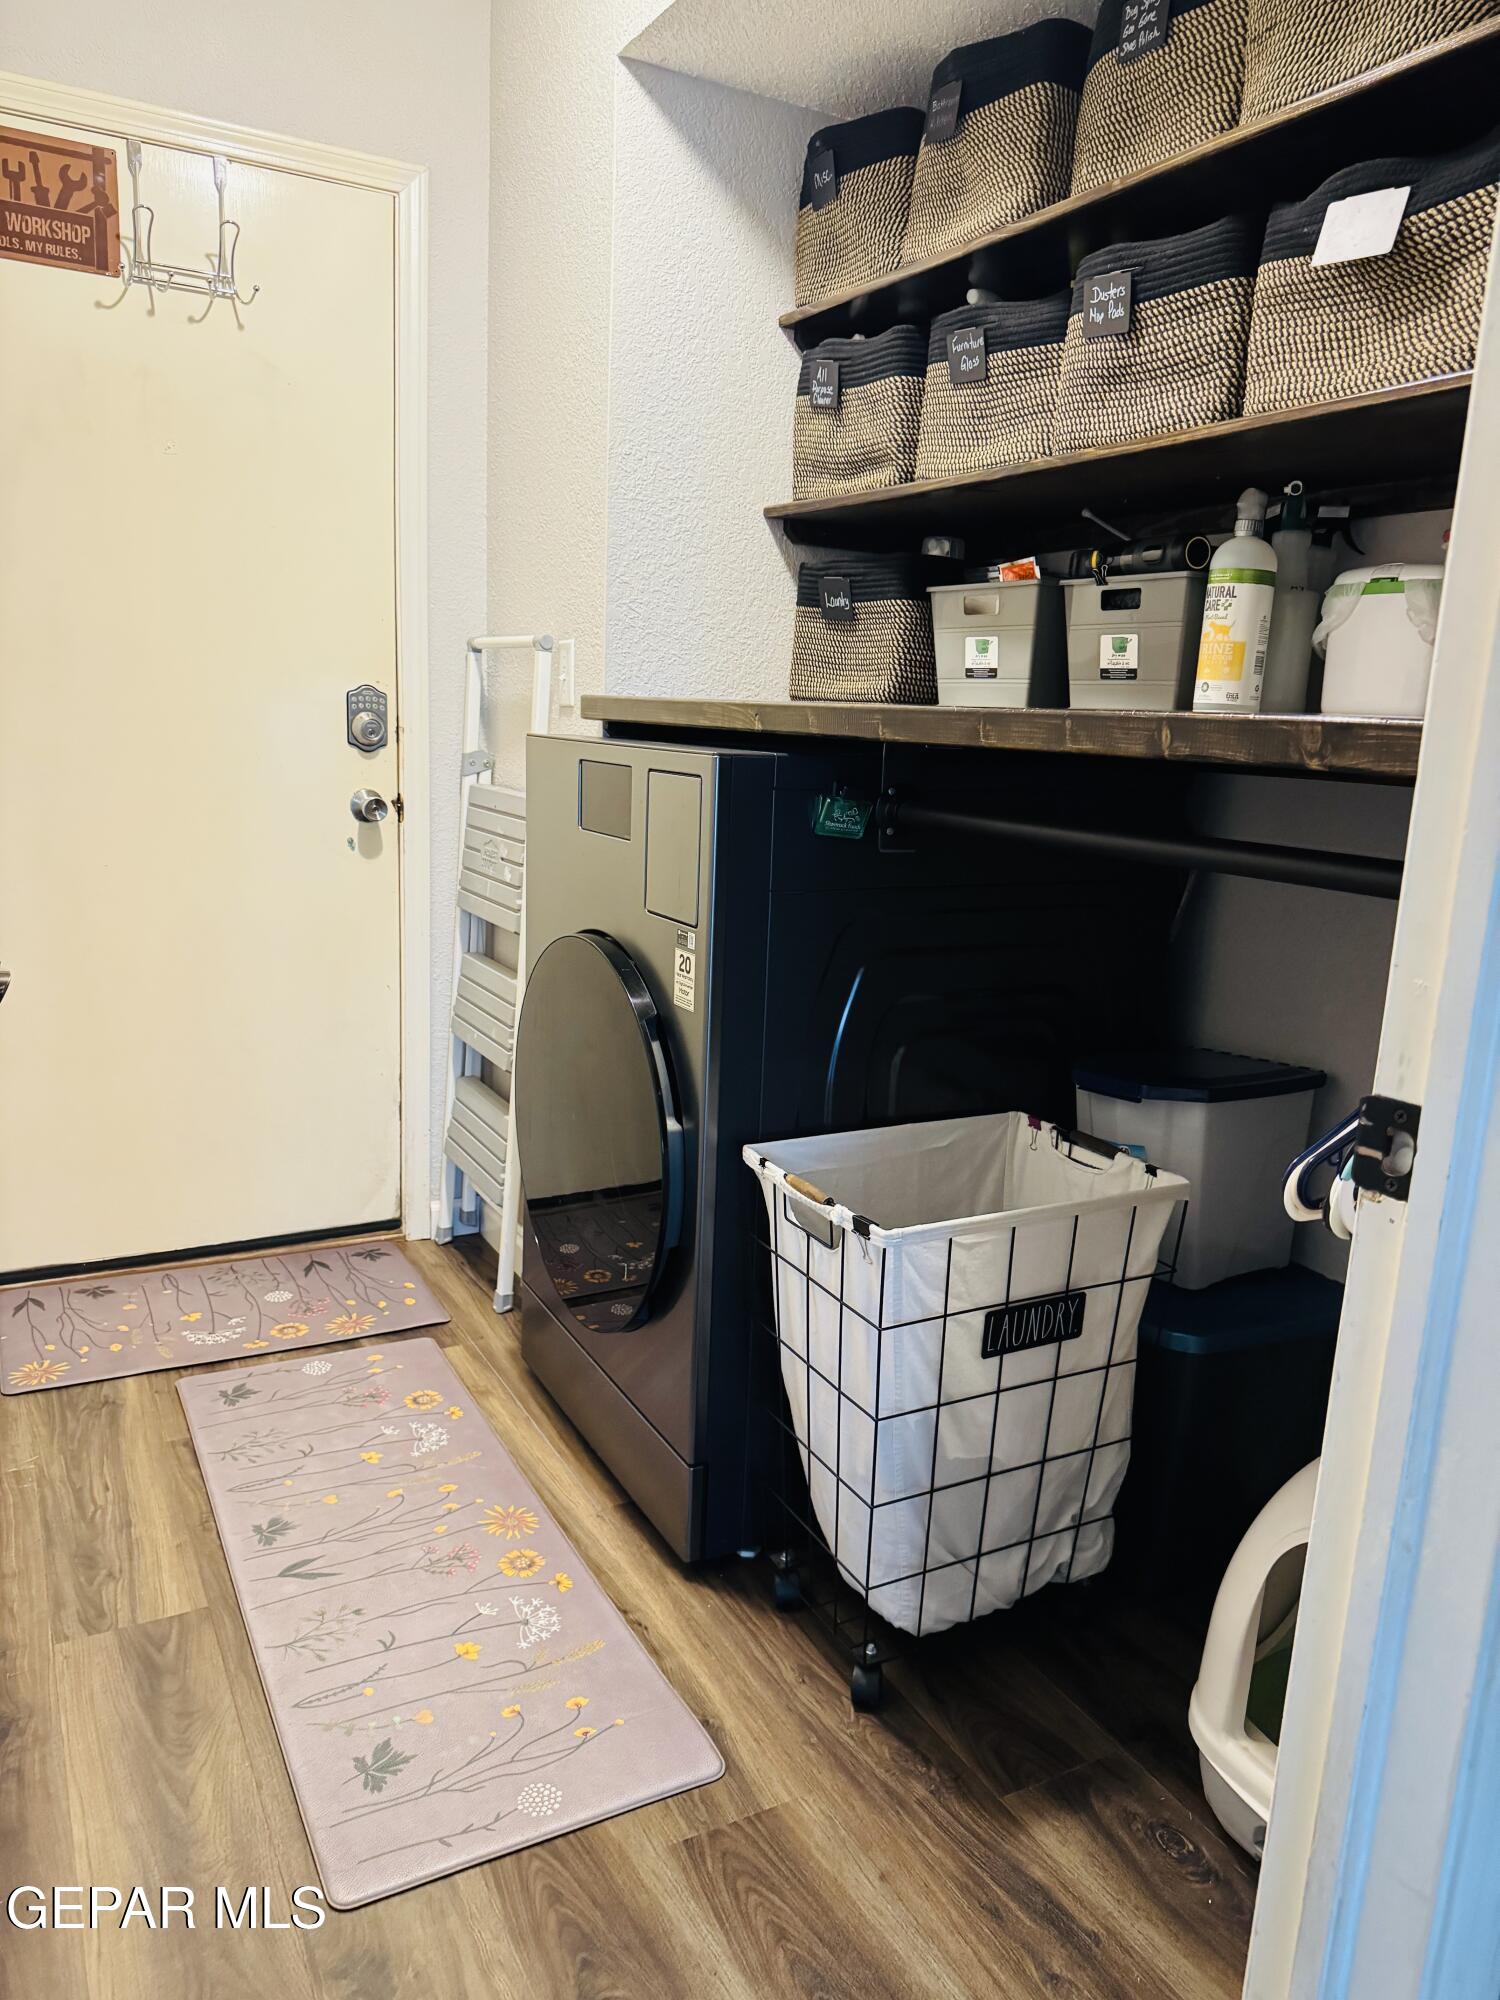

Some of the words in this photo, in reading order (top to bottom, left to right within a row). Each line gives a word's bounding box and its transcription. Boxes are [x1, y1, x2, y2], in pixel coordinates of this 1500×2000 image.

[5, 211, 92, 245] WORKSHOP
[25, 240, 44, 254] MY
[45, 243, 83, 261] RULES.
[1090, 281, 1126, 304] Dusters
[951, 331, 985, 354] Furniture
[816, 366, 828, 383] All
[824, 591, 850, 610] Laundry
[678, 953, 692, 975] 20
